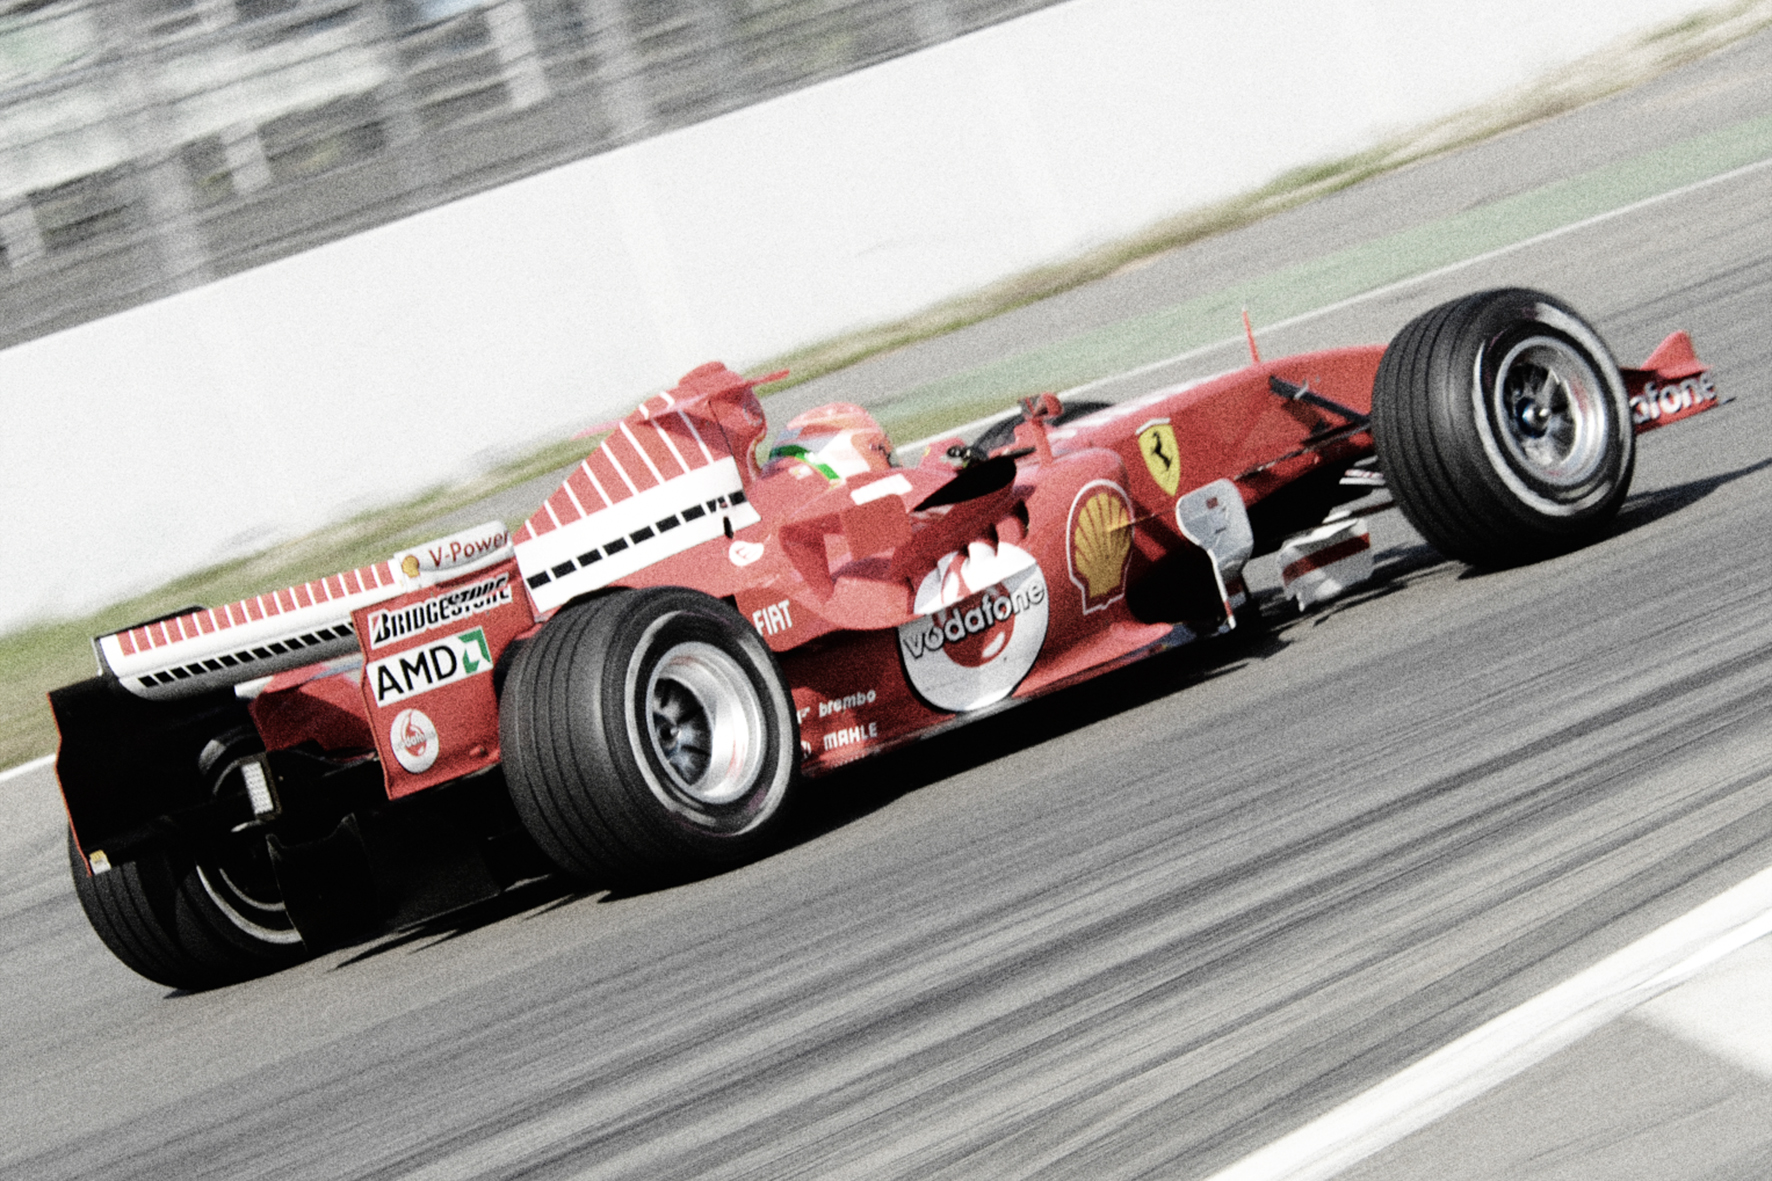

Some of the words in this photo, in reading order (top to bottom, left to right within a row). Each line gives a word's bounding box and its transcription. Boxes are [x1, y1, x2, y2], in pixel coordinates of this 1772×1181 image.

[1629, 371, 1716, 424] afone
[428, 530, 508, 568] V-Power
[374, 577, 509, 645] BRIDGESTONE
[752, 599, 793, 636] FIAT
[903, 578, 1046, 659] vodafone
[377, 645, 458, 701] AMD
[819, 689, 876, 718] brembo
[823, 721, 878, 751] MAHLE
